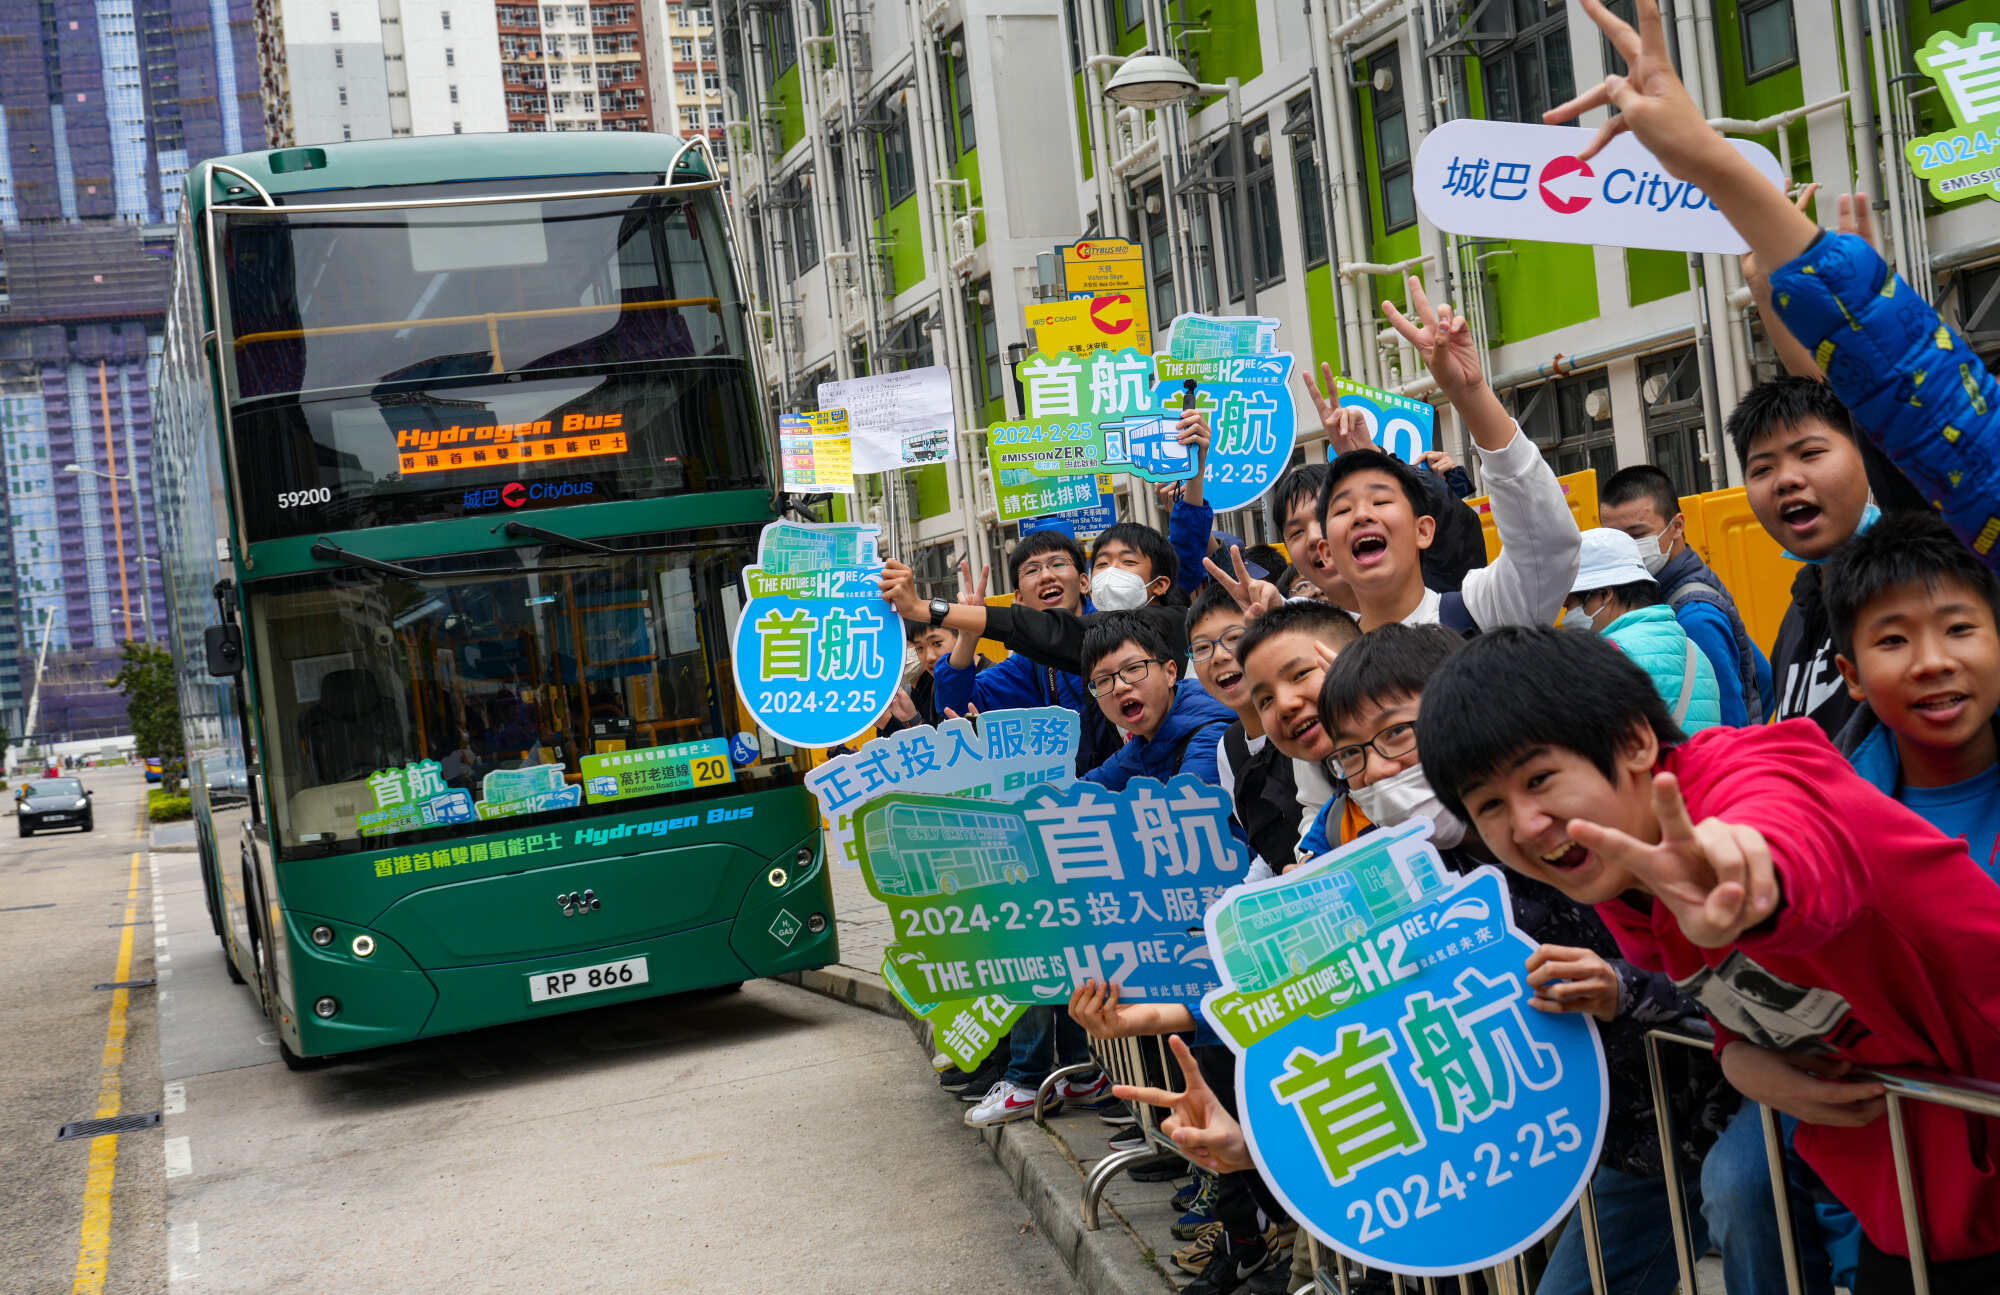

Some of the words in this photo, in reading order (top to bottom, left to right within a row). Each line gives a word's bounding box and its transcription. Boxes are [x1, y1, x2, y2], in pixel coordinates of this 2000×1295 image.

[1925, 31, 2000, 124] 首
[1915, 126, 2000, 170] 2024·
[1442, 155, 1532, 201] 城巴
[1602, 167, 1721, 213] Cityb
[1023, 353, 1151, 418] 首航
[1165, 362, 1184, 377] THE
[1185, 362, 1213, 375] FUTURE
[397, 420, 552, 451] Hydrogen
[562, 413, 623, 432] Bus
[993, 422, 1093, 445] 2024·2·25
[277, 487, 332, 509] 59200
[462, 488, 499, 509] 城巴
[528, 480, 594, 500] Citybus
[1003, 483, 1092, 514] 請在此排隊
[758, 578, 778, 593] THE
[780, 576, 809, 591] FUTURE
[755, 607, 884, 682] 首航
[759, 689, 877, 713] 2024·2·25
[619, 763, 690, 787] 窩打老道線
[696, 759, 725, 781] 20
[813, 716, 1069, 813] 正式投入服務
[1003, 765, 1066, 792] Bus
[369, 762, 445, 808] 首航
[625, 783, 655, 795] Waterloo
[656, 781, 674, 791] Road
[373, 832, 563, 878] 香港首輛雙層氫能巴士
[574, 814, 699, 847] Hydrogen
[706, 806, 754, 825] Bus
[1024, 784, 1238, 885] 首航
[778, 928, 794, 937] GAS
[900, 896, 1081, 937] 2024·2·25
[546, 972, 577, 997] RP
[588, 963, 634, 988] 866
[917, 960, 974, 993] THE
[975, 956, 1050, 987] FUTURE
[1049, 955, 1067, 977] IS
[1237, 992, 1286, 1033] THE
[1282, 965, 1342, 1012] FUTURE
[1337, 958, 1355, 981] IS
[1271, 967, 1563, 1187] 首航
[1346, 1106, 1583, 1245] 2024·2·25
